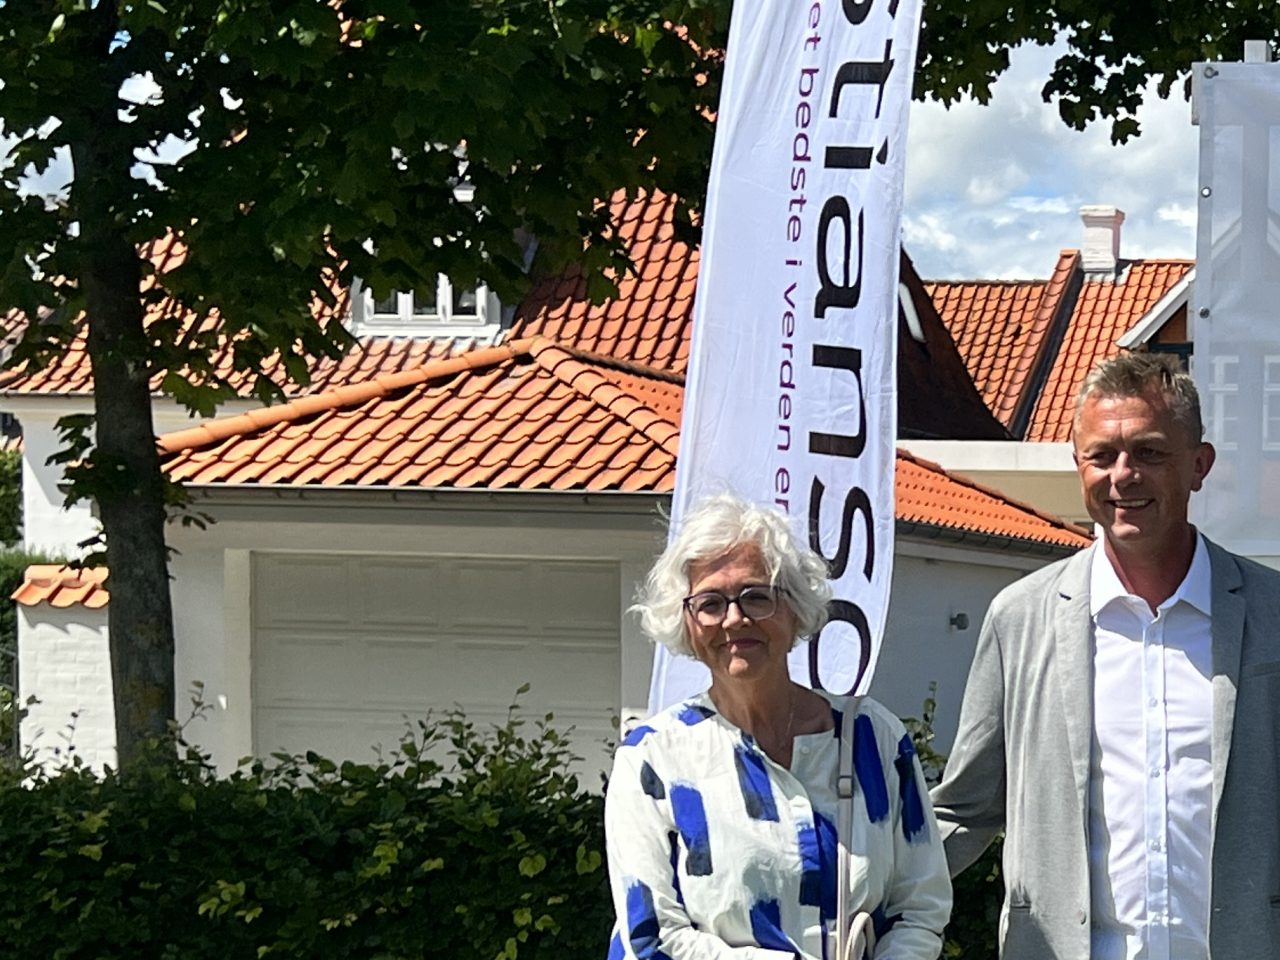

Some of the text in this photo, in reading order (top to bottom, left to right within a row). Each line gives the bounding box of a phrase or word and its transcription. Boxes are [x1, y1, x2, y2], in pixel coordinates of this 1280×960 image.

[786, 67, 820, 243] bedste
[784, 258, 803, 267] i
[807, 0, 900, 698] tianso
[776, 282, 798, 452] verden
